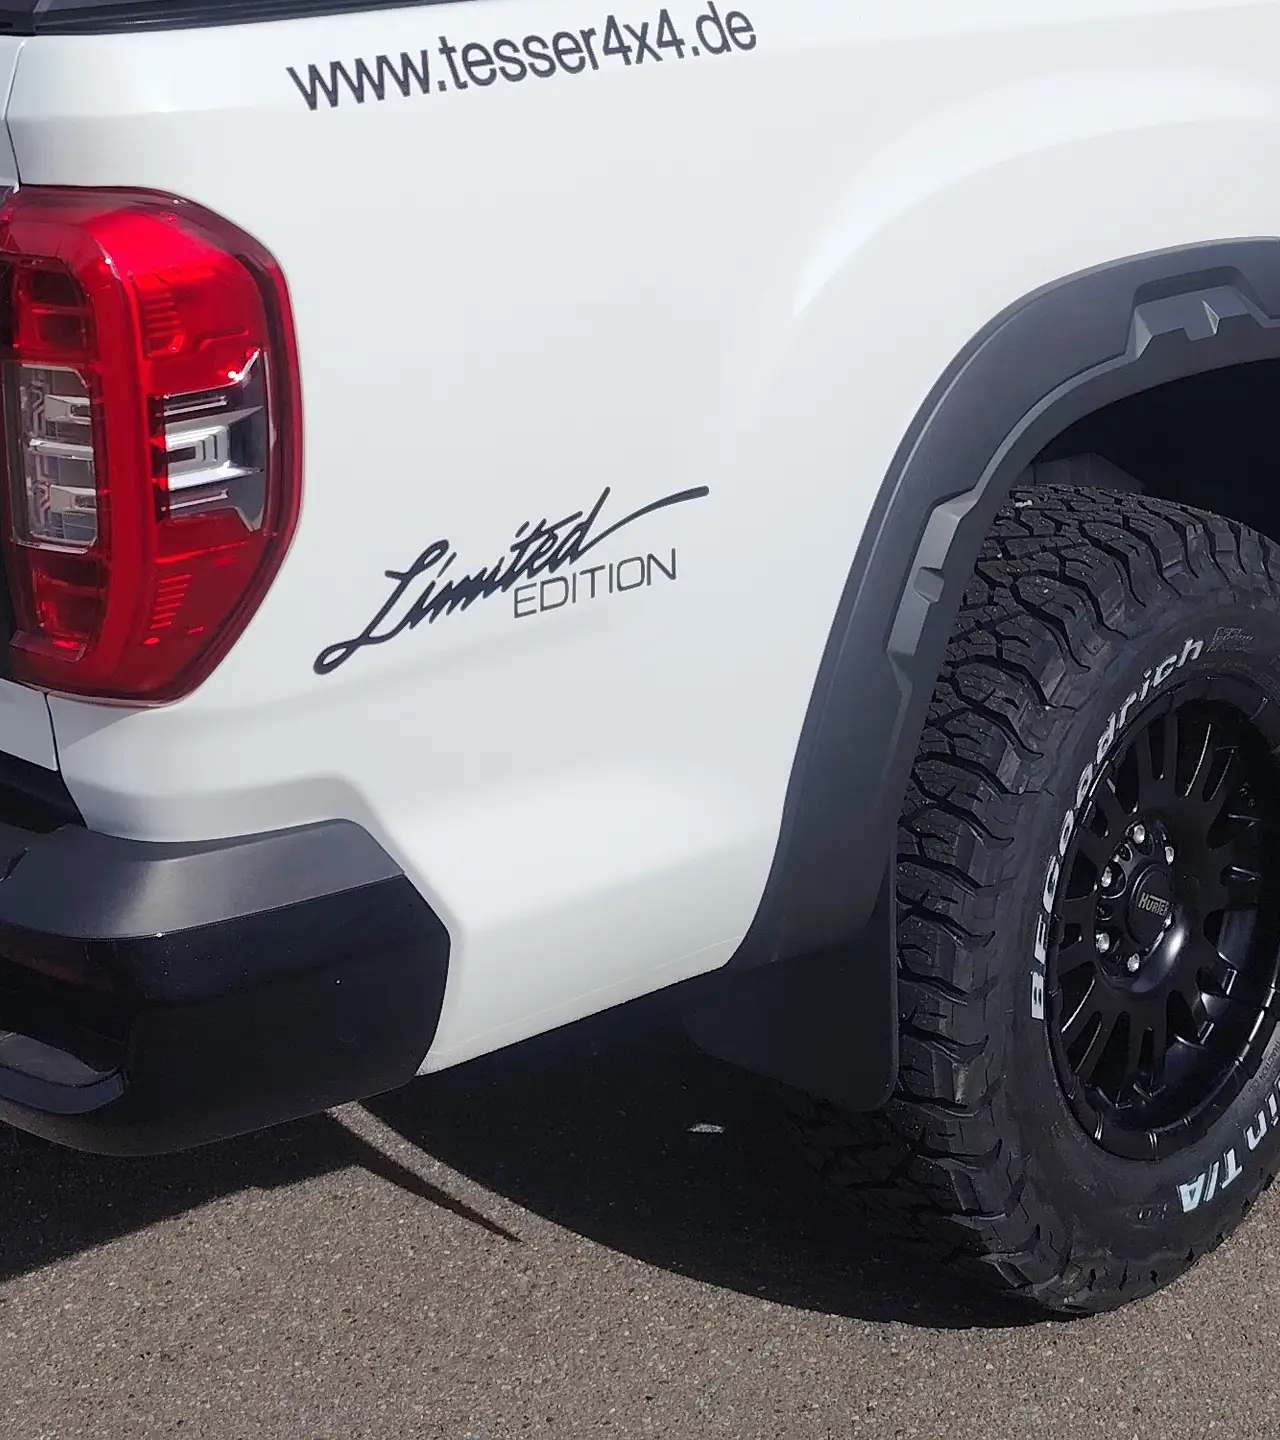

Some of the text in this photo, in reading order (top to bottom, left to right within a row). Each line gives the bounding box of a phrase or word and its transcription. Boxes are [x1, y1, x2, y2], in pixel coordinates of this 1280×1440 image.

[286, 0, 757, 111] www.tesser4x4.de
[313, 486, 709, 675] Limited
[513, 548, 677, 619] EDITION
[1030, 638, 1204, 1021] BFGoodrich
[1178, 1157, 1245, 1214] T/A
